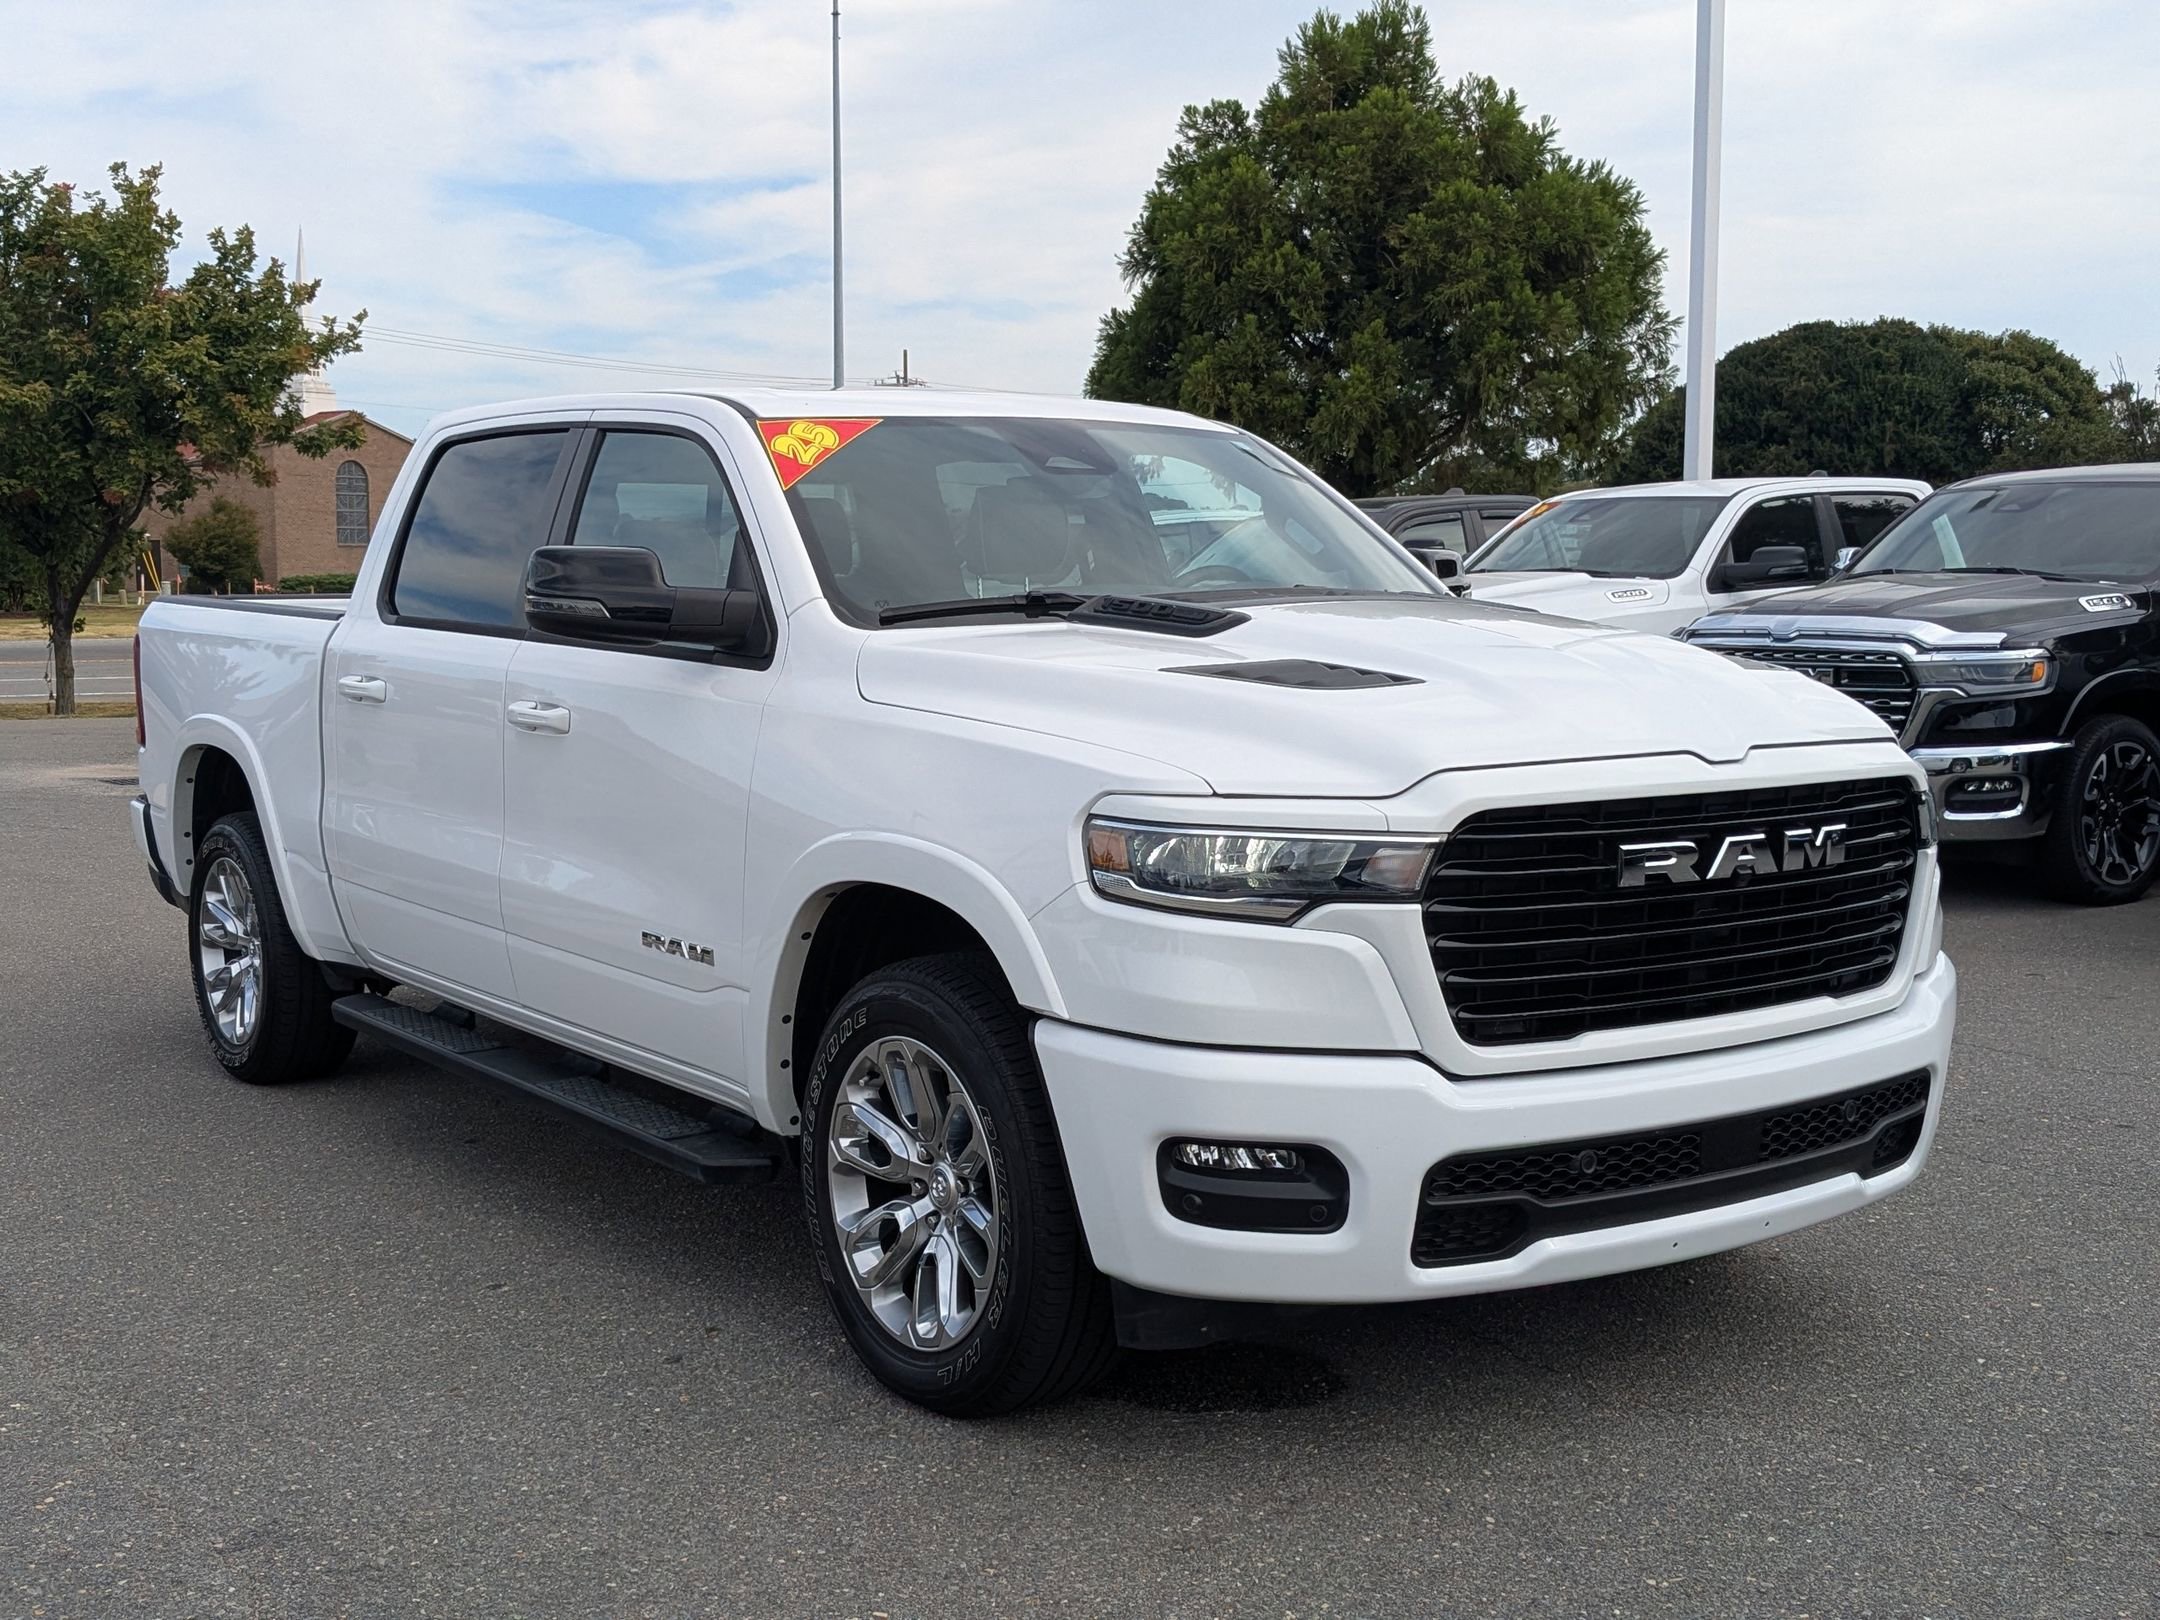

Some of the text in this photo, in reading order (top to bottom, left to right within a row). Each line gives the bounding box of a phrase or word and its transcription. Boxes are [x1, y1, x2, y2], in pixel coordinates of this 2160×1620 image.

[771, 421, 839, 465] 25
[2087, 596, 2122, 606] 1500
[1617, 824, 1847, 887] RAM
[641, 930, 715, 967] RAM
[802, 1007, 867, 1286] BRIDGESTONE
[937, 1105, 1013, 1385] DUELER H/L
